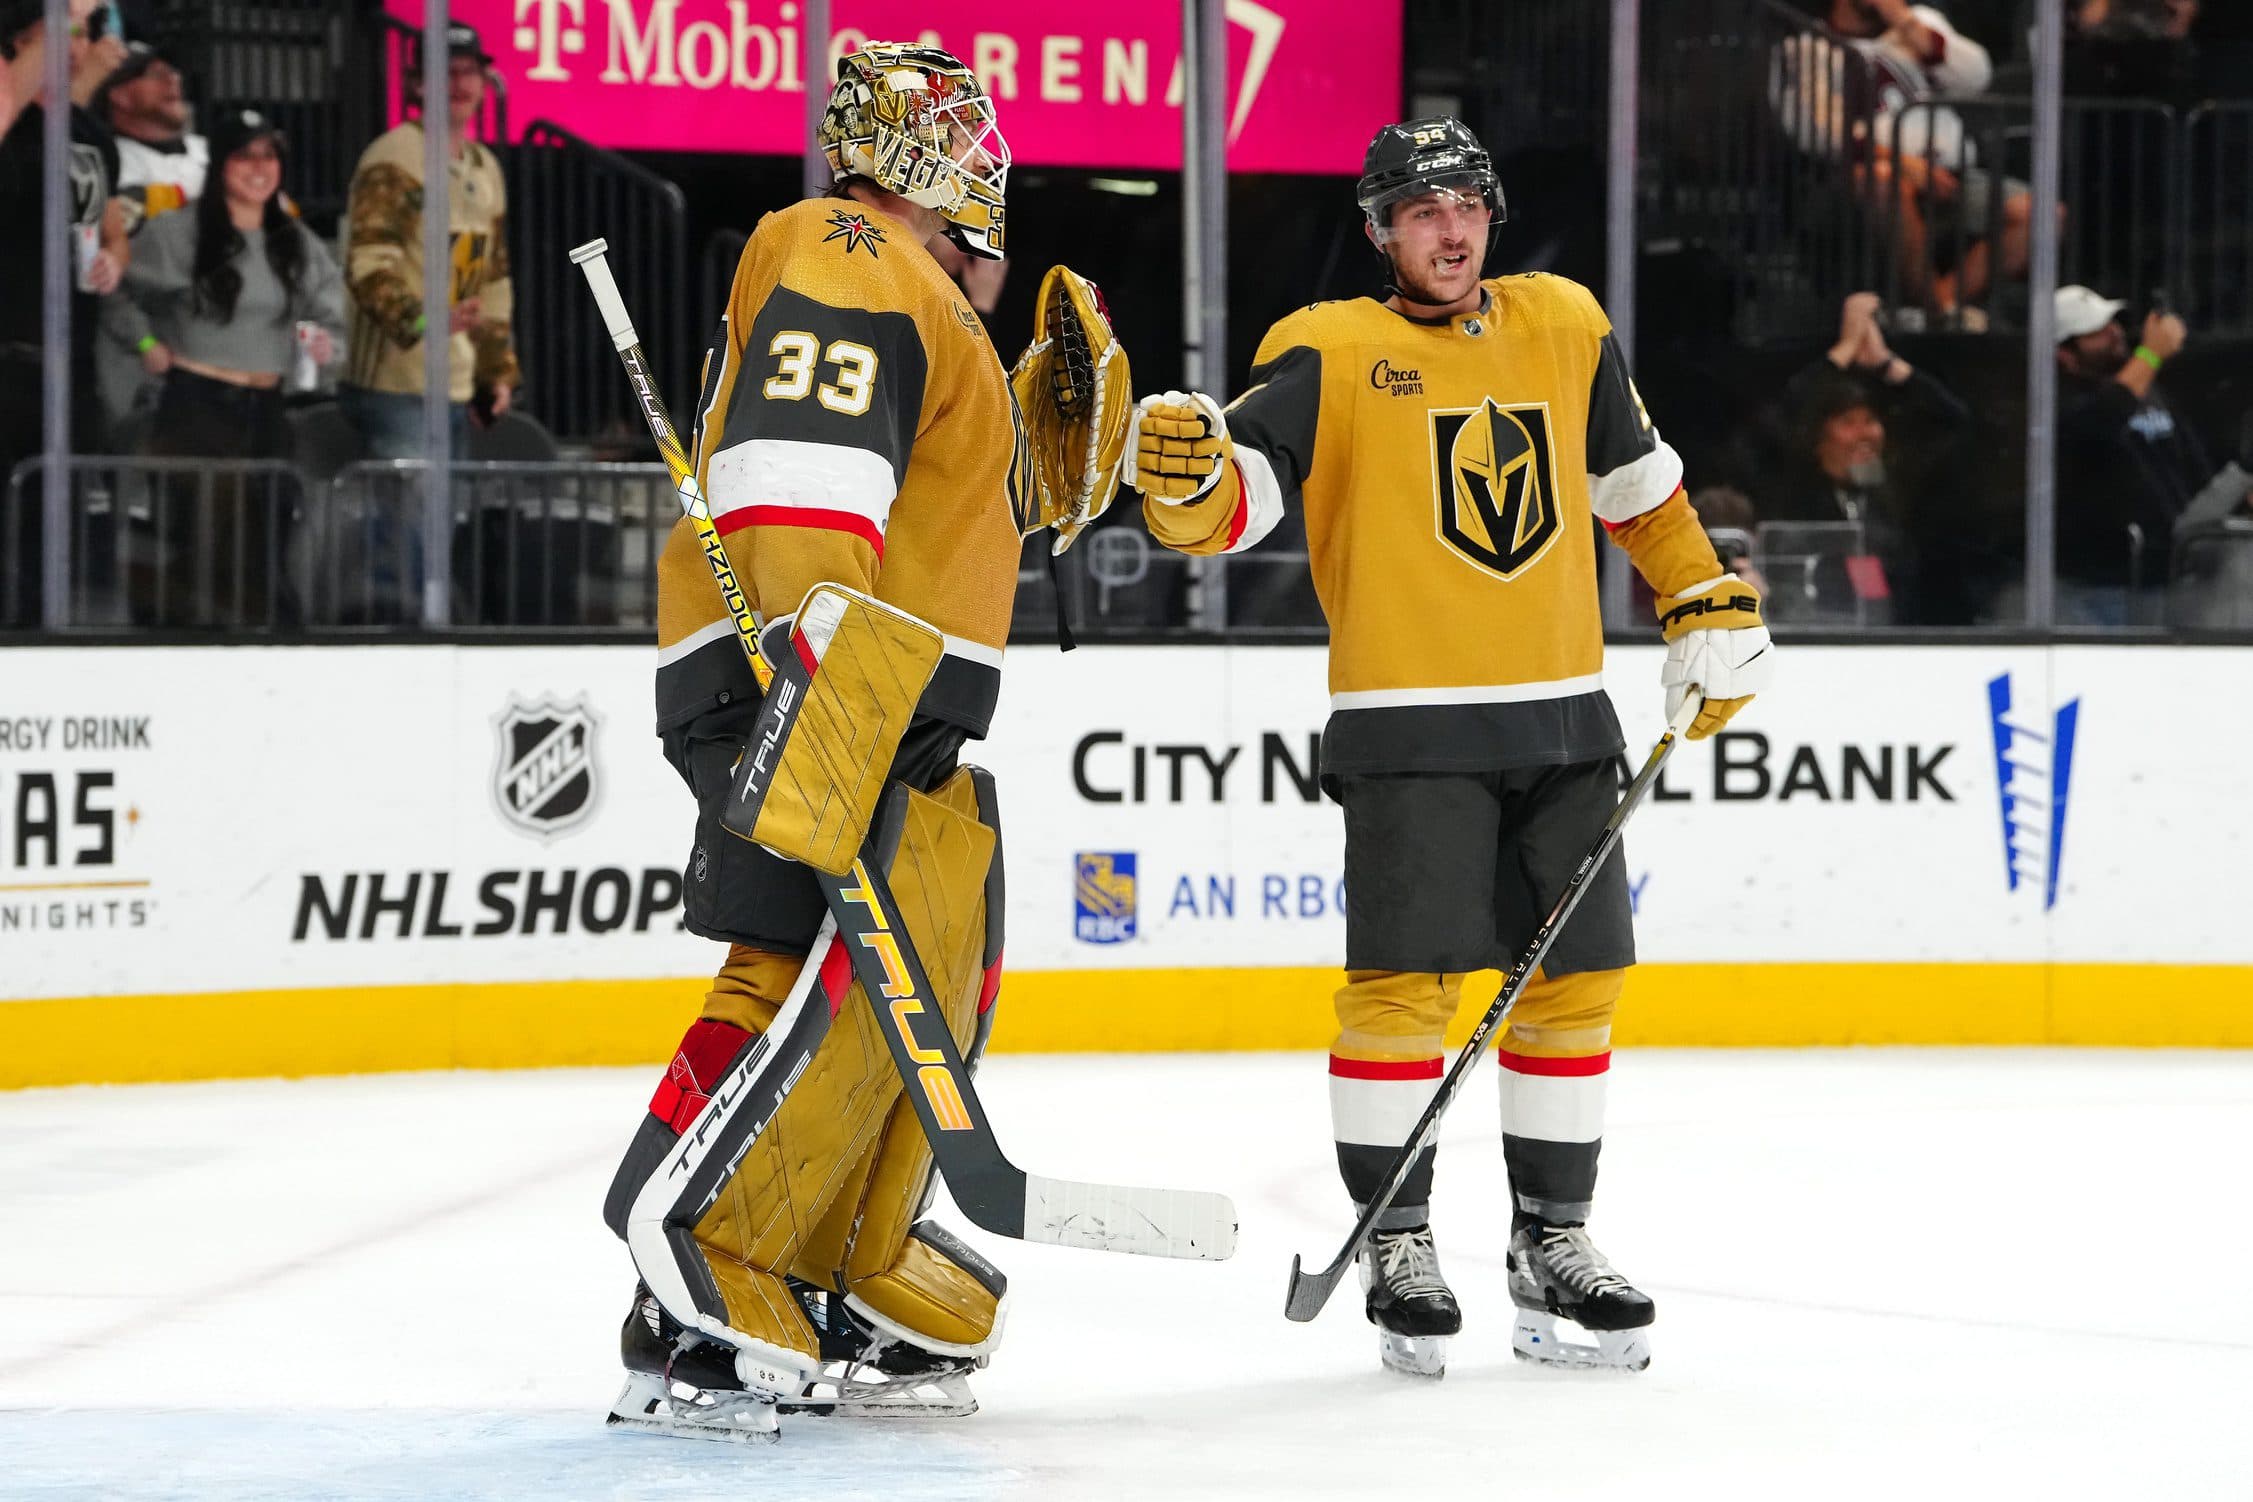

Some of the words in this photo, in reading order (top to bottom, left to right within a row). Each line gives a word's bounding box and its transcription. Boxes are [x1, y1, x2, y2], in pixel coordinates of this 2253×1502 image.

[514, 0, 585, 81] T
[599, 0, 868, 91] Mobi
[916, 30, 1184, 108] REN
[1414, 128, 1447, 145] 94
[1416, 154, 1465, 172] CCM
[626, 349, 669, 440] TRUE
[762, 330, 879, 417] 33
[1371, 359, 1422, 389] Circa
[1391, 383, 1424, 397] SPORTS
[699, 530, 761, 656] HZRDUS
[1660, 595, 1757, 632] TRUE
[63, 716, 151, 750] DRINK
[515, 732, 583, 807] NHL
[741, 678, 797, 804] TRUE
[1169, 875, 1235, 918] AN
[839, 857, 975, 1131] TRUE
[668, 1033, 771, 1182] TRUE
[694, 1050, 812, 1217] TRUE
